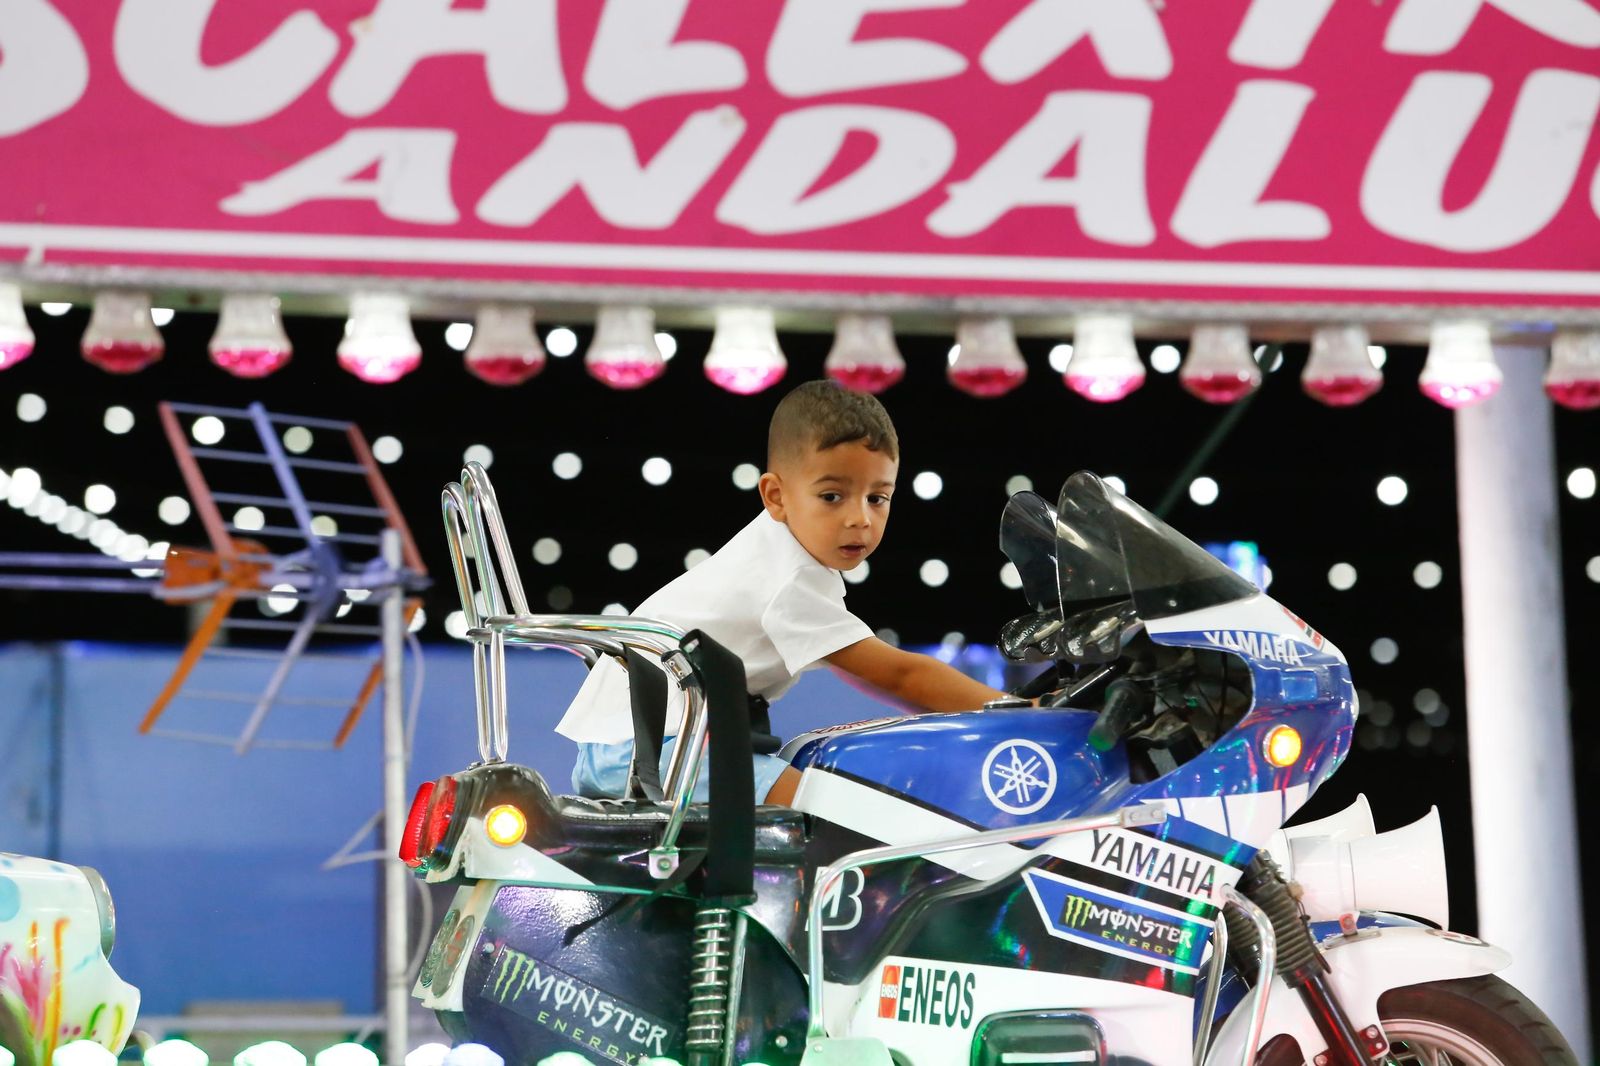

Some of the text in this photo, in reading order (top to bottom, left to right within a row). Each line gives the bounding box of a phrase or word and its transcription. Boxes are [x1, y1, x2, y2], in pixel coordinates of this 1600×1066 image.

[218, 68, 1600, 253] ANDALU
[1203, 630, 1304, 667] YAMAHA
[1090, 828, 1217, 900] YAMAHA
[1088, 903, 1194, 949] MONSTER
[1101, 930, 1176, 957] ENERGY
[526, 967, 668, 1056] MONSTER
[898, 965, 976, 1030] ENEOS
[537, 1011, 636, 1063] ENERGY
